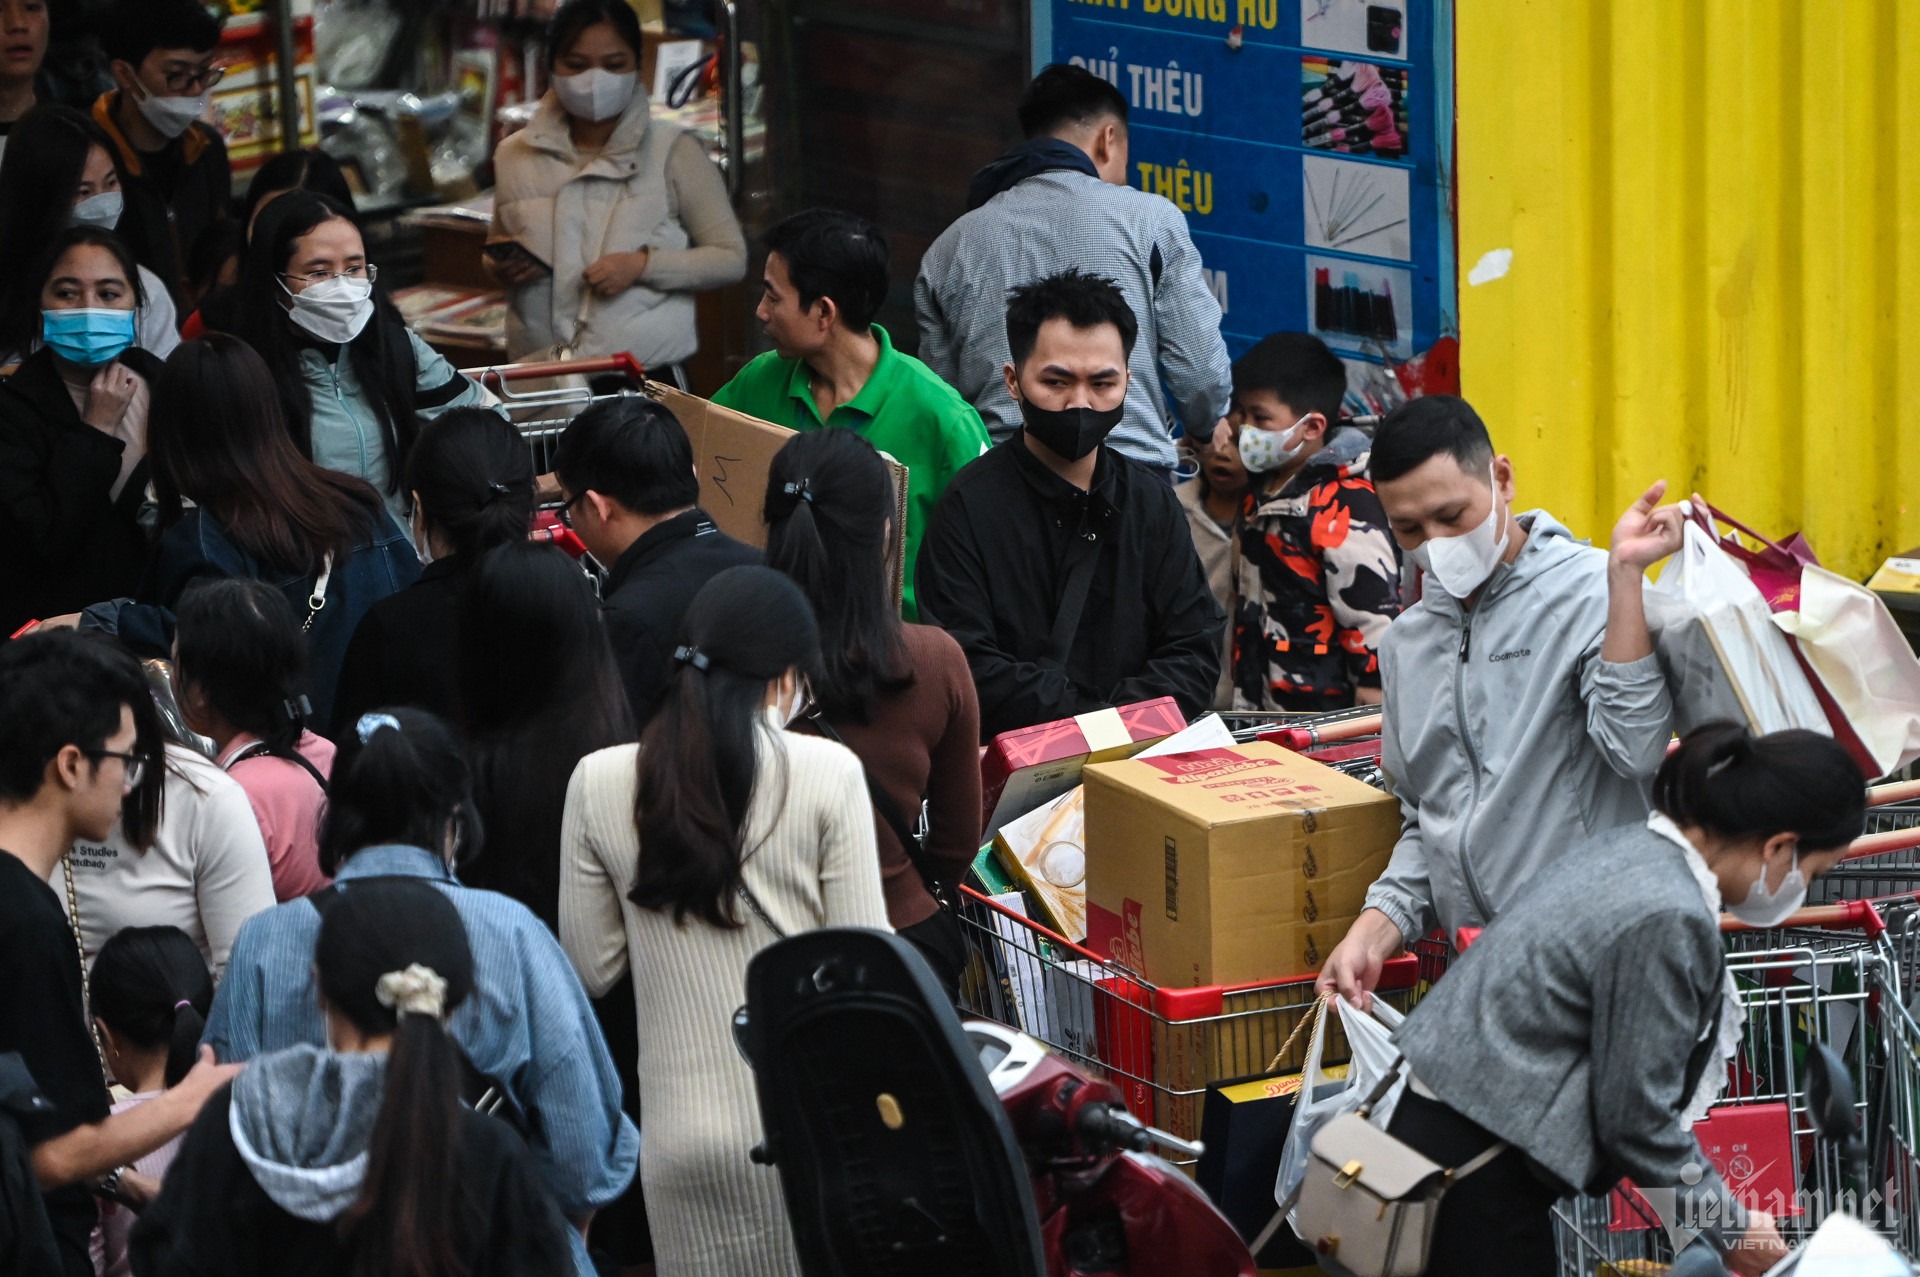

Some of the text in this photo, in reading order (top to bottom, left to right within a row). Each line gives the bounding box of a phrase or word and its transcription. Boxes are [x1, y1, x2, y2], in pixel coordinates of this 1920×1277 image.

[1127, 60, 1203, 117] THÊU
[1136, 158, 1212, 215] THÊU
[1176, 758, 1270, 784] Alpenliebe
